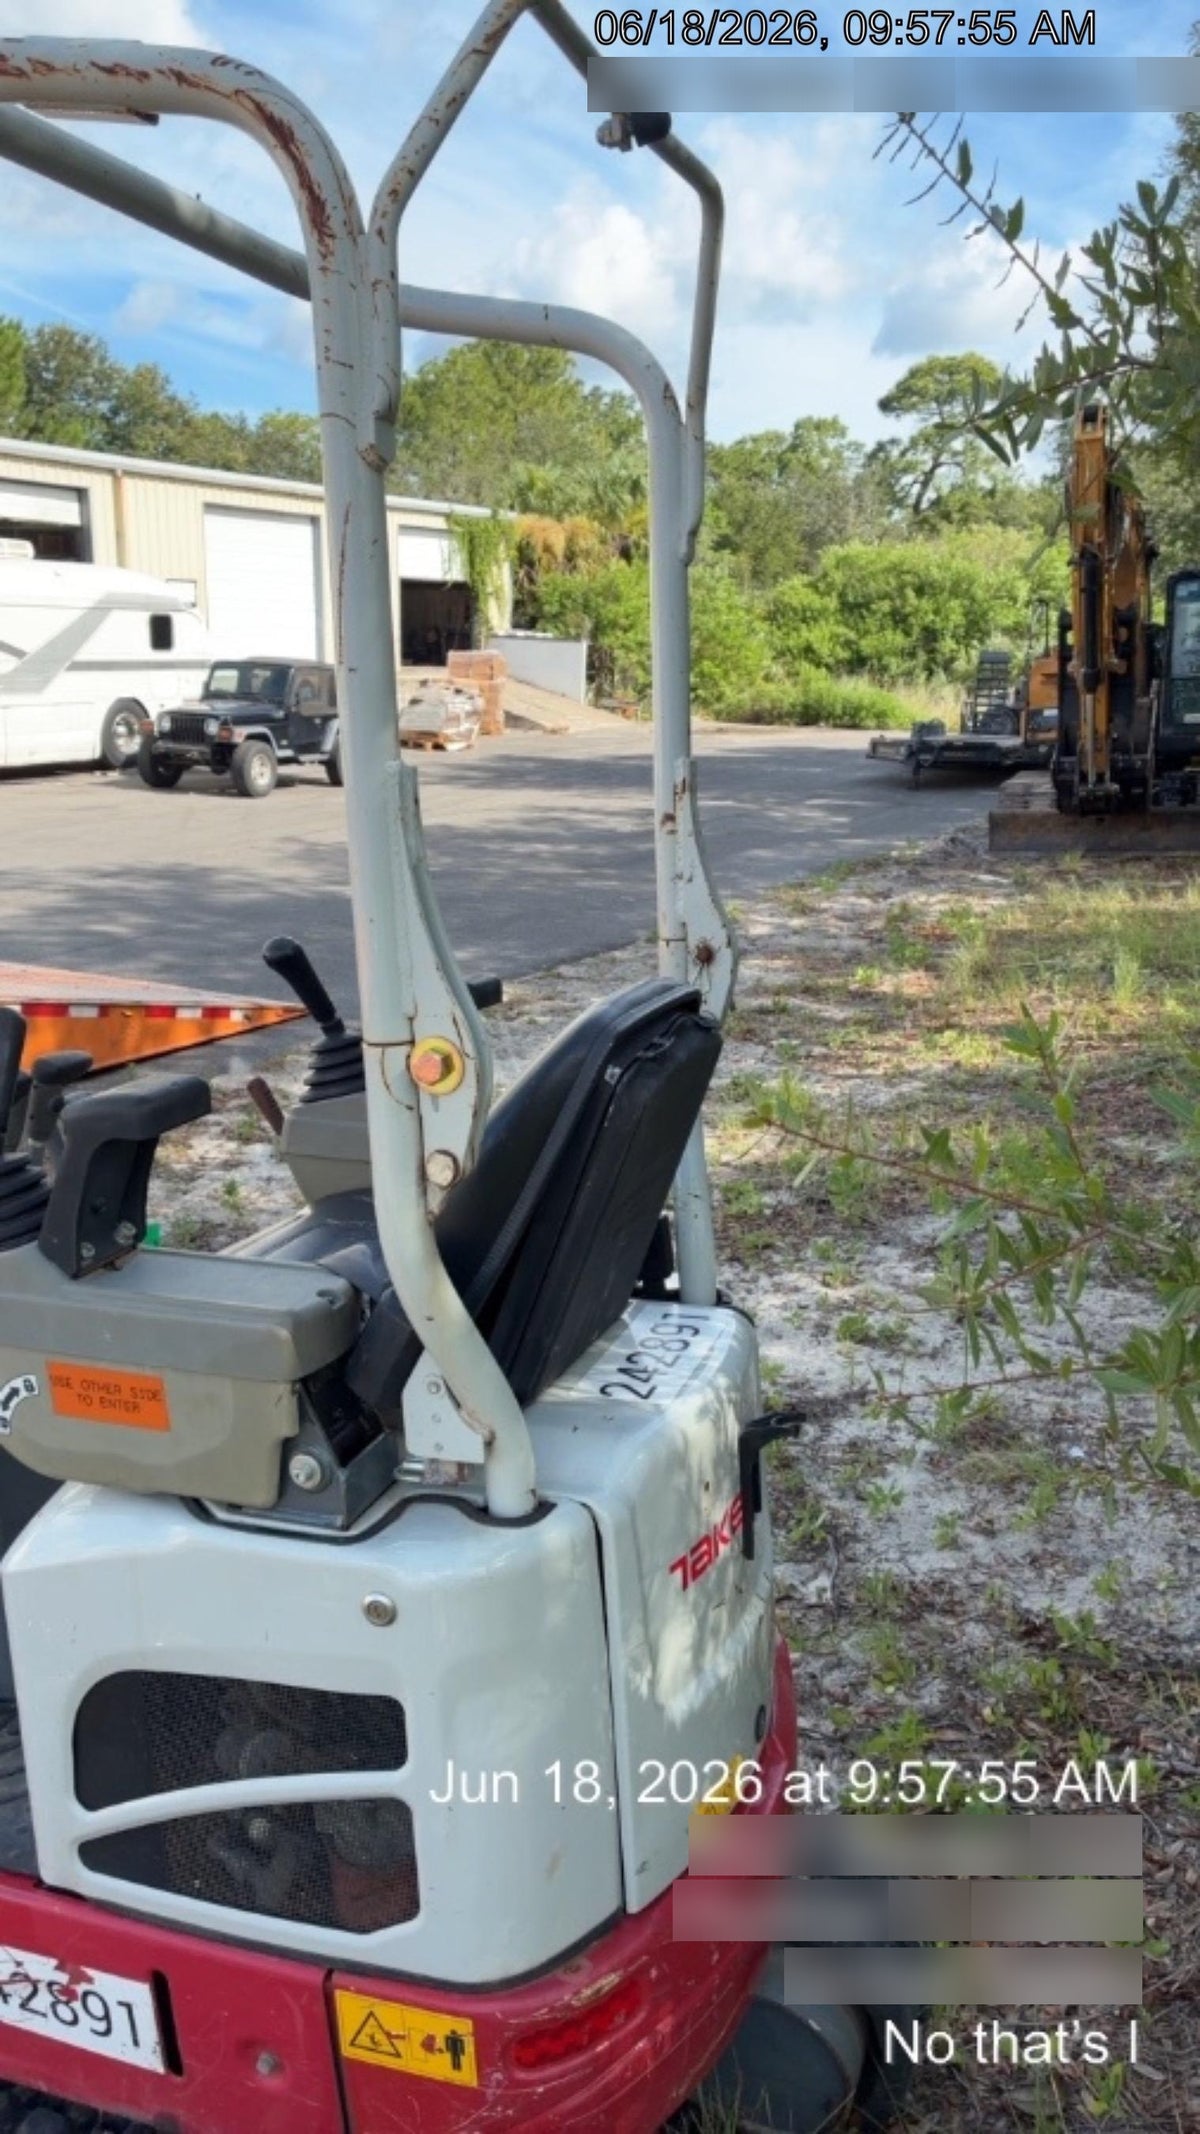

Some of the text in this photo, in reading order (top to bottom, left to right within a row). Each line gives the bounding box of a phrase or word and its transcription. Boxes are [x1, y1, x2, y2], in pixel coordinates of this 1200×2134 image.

[599, 1312, 710, 1400] 242891
[80, 1379, 122, 1395] OTHER
[77, 1393, 93, 1407] TO
